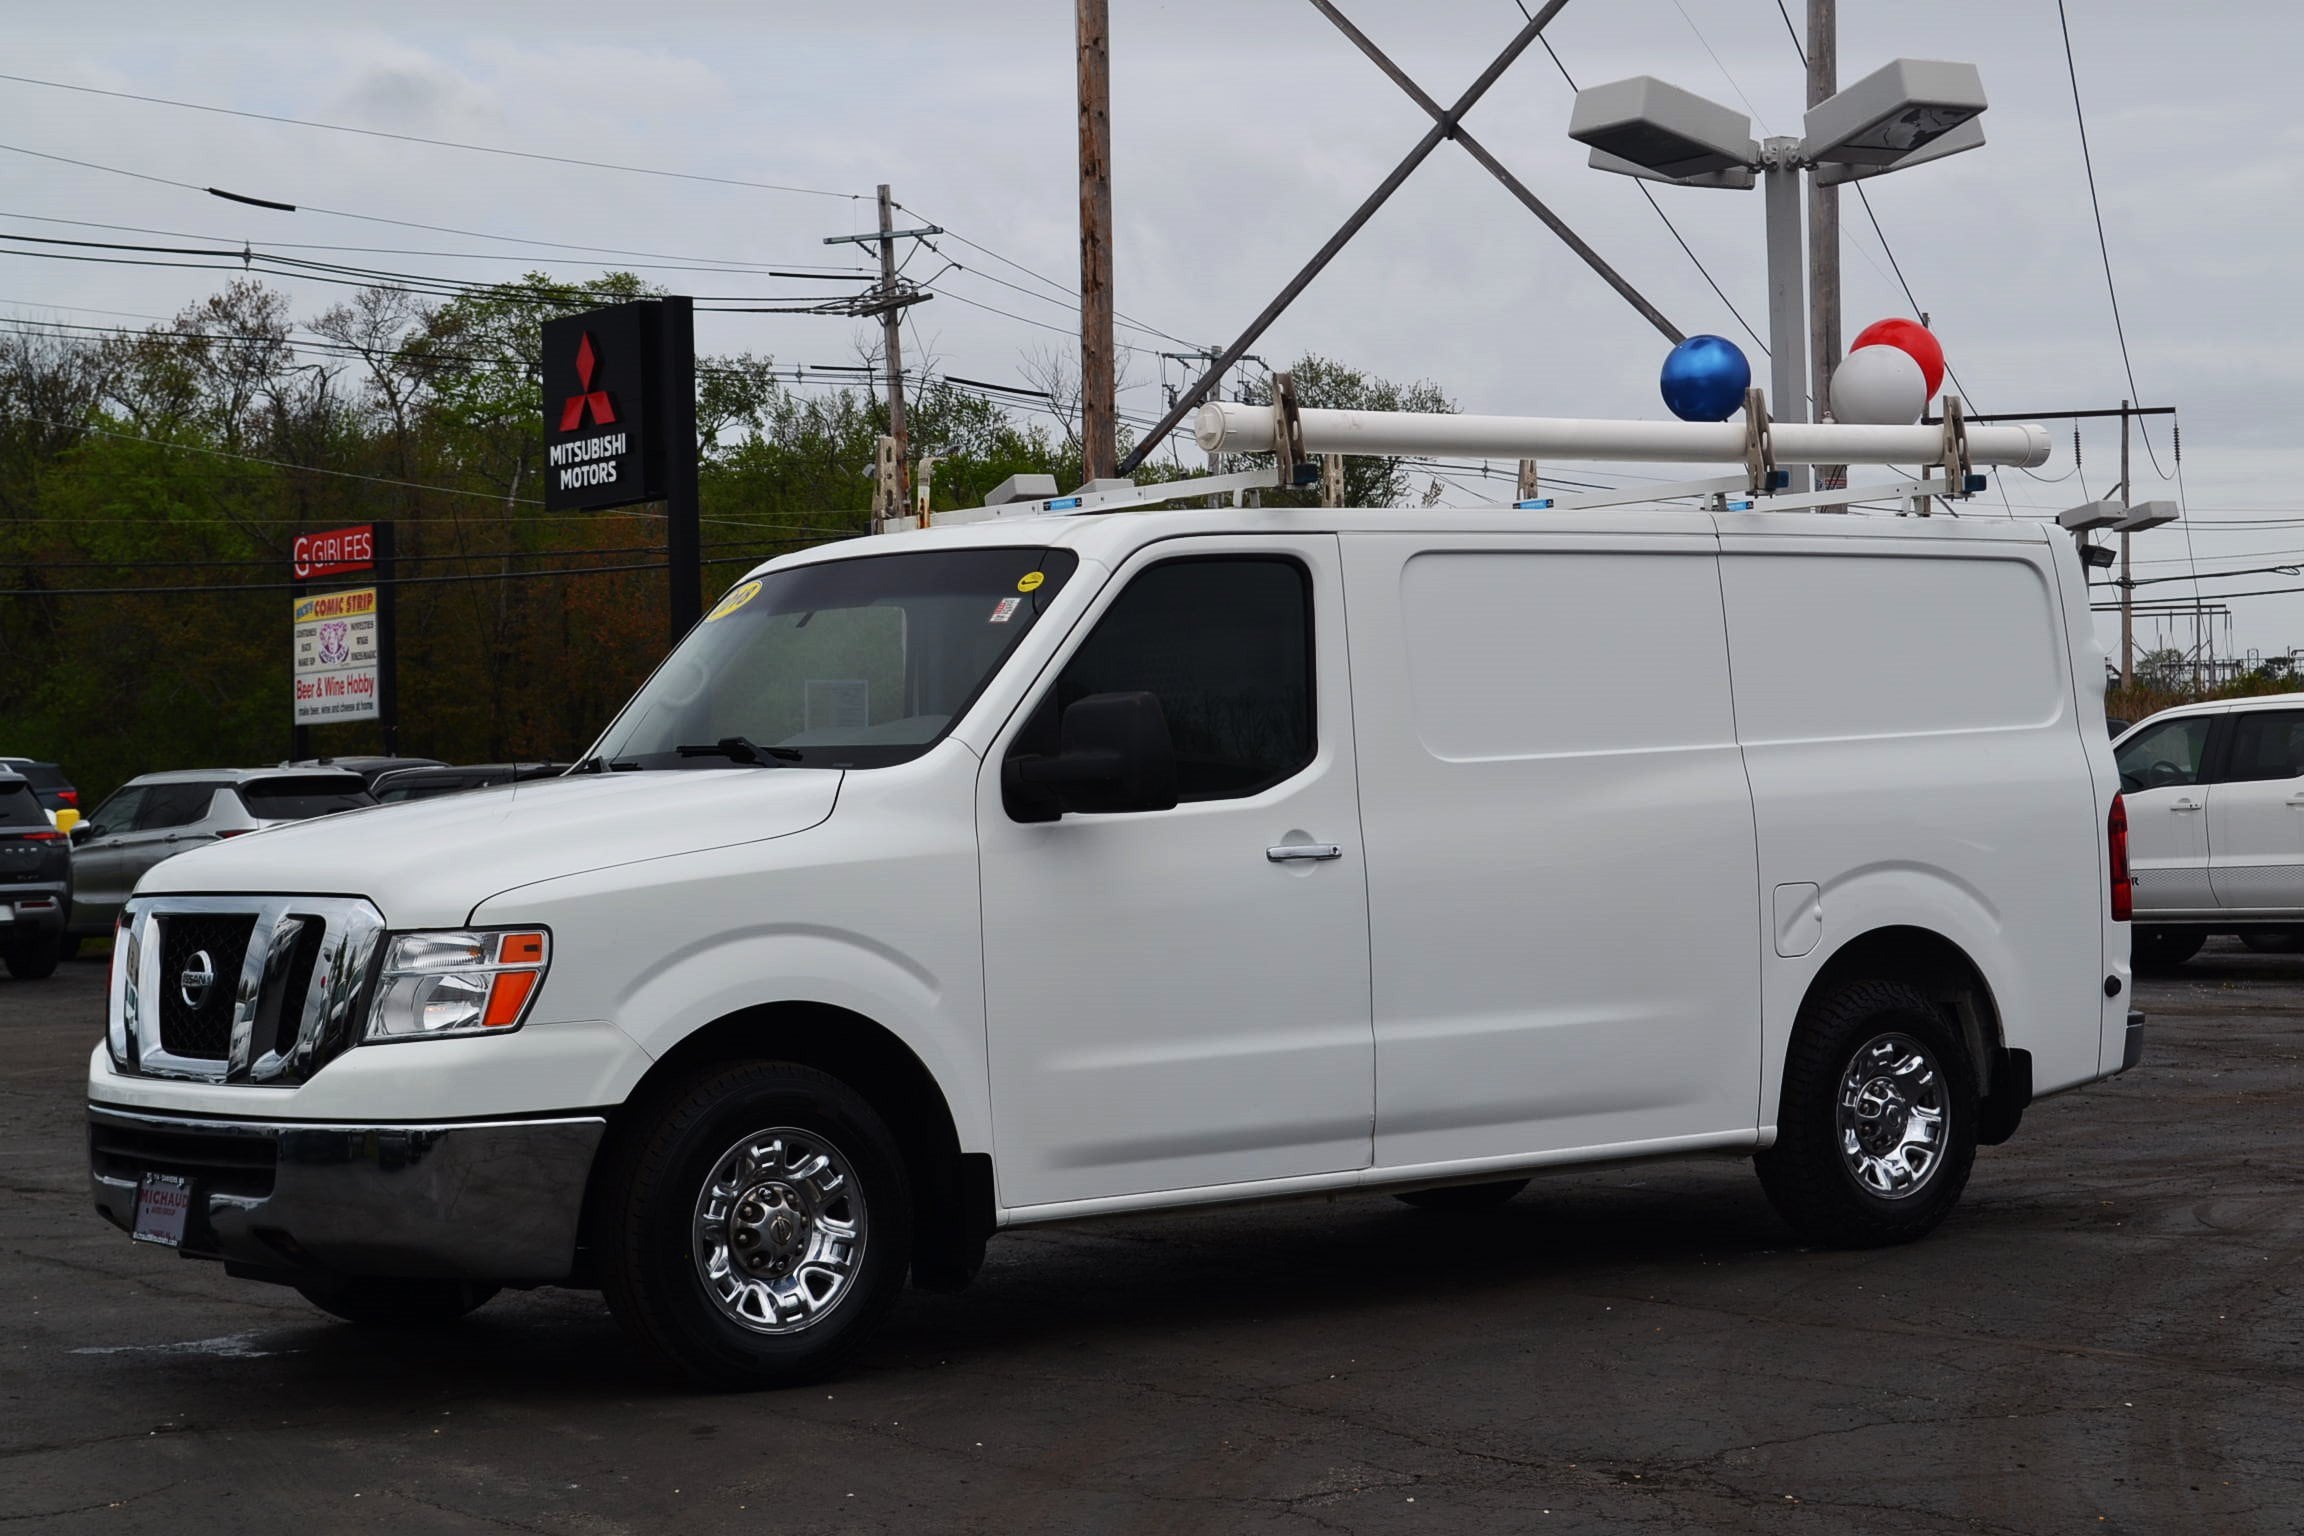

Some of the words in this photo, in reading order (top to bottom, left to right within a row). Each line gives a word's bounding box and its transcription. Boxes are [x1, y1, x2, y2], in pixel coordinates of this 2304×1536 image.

[549, 432, 626, 467] MITSUBISHI
[560, 460, 617, 490] MOTORS
[294, 537, 309, 576] G
[314, 596, 344, 616] COMIC
[346, 592, 374, 613] STRIP
[296, 679, 315, 700] Beer
[316, 677, 323, 698] &
[324, 676, 345, 696] Wine
[347, 673, 375, 698] Hobby
[182, 973, 206, 985] ISSAN
